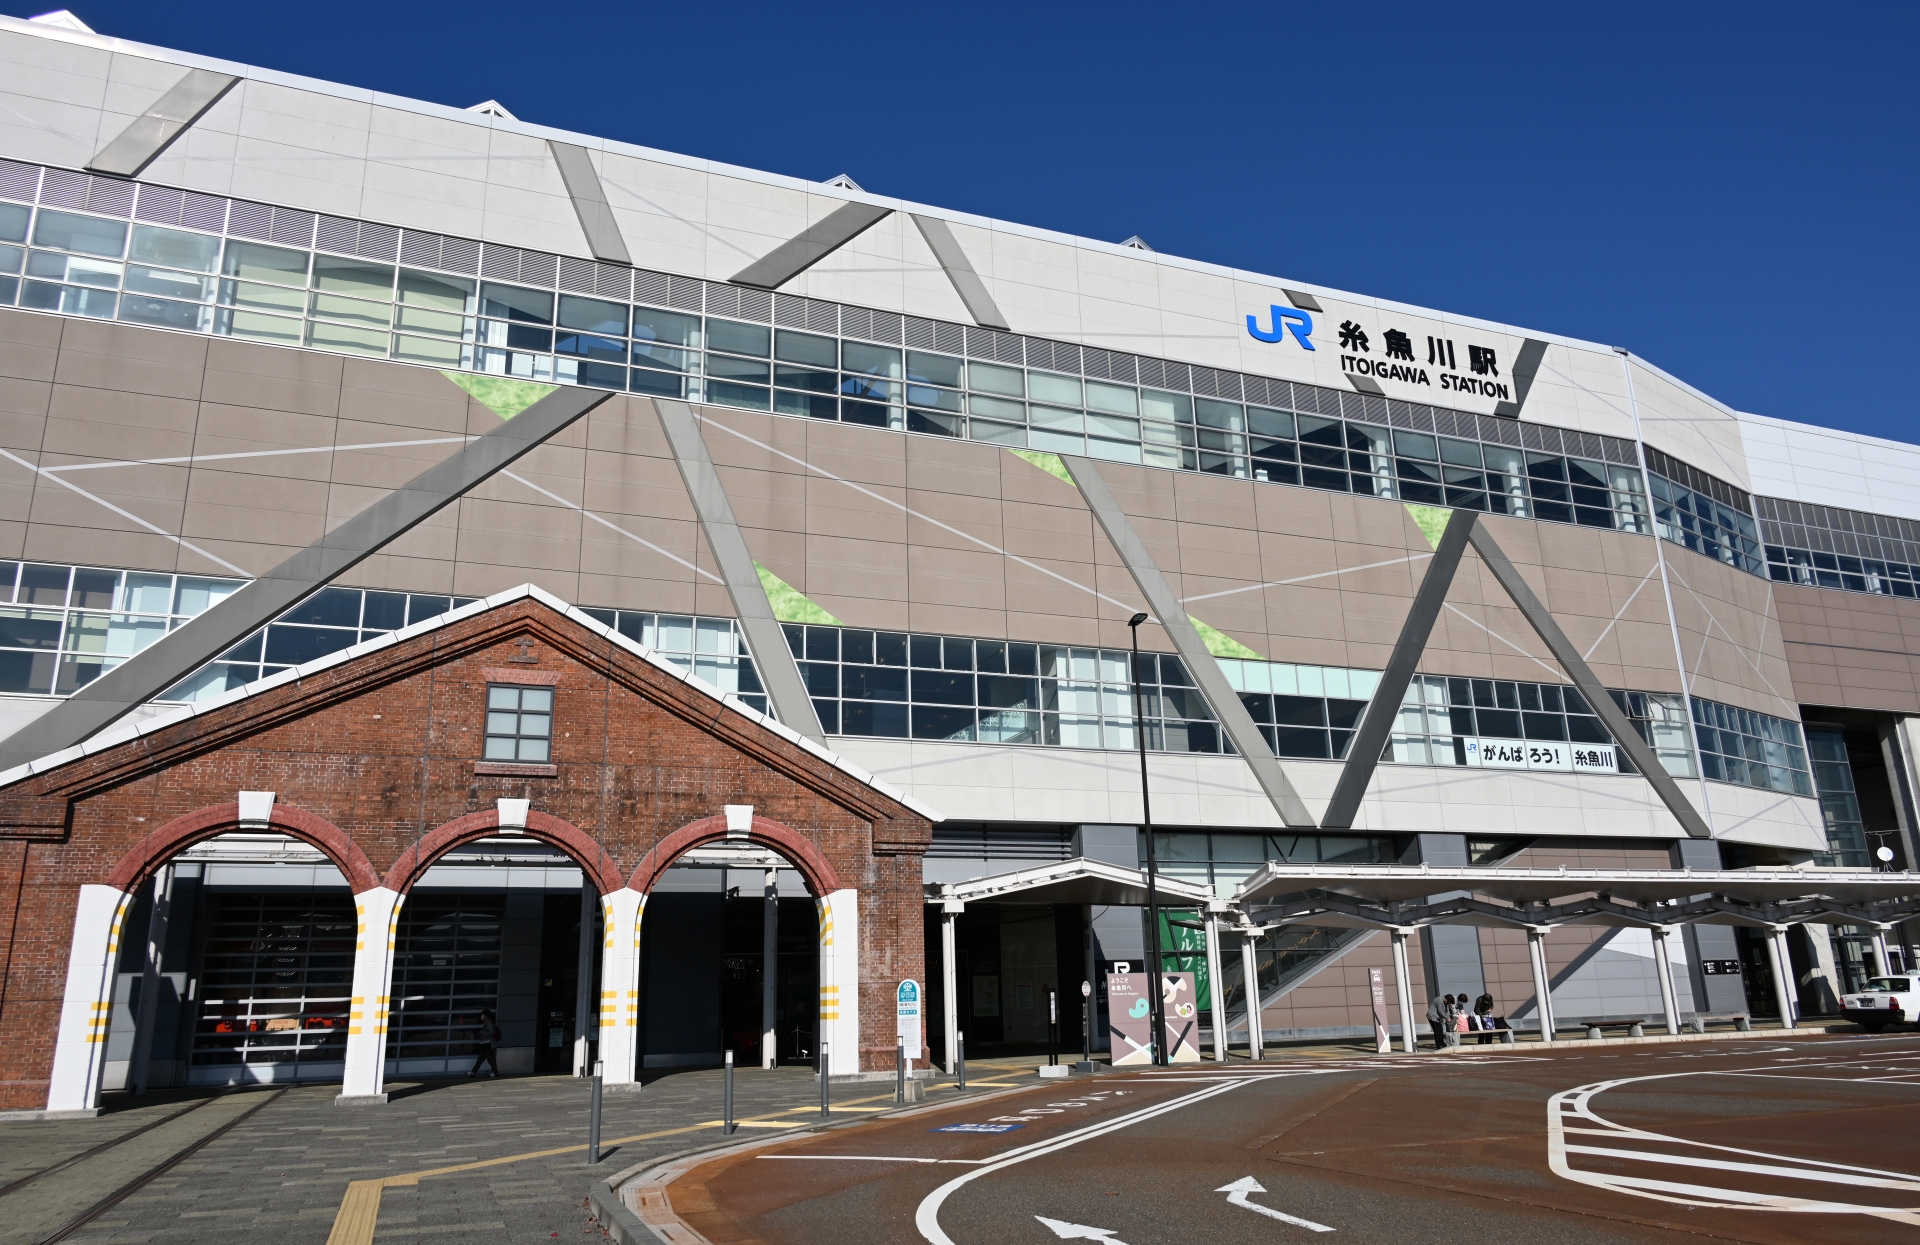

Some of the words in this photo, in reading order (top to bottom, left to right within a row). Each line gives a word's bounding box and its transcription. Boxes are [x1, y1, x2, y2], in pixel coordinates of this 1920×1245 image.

[1246, 304, 1316, 351] JR
[1338, 319, 1499, 377] 糸魚川駅
[1340, 354, 1430, 386] ITOIGAWA
[1441, 373, 1509, 400] STATION
[1467, 743, 1477, 751] JR
[1575, 749, 1614, 767] 糸魚川
